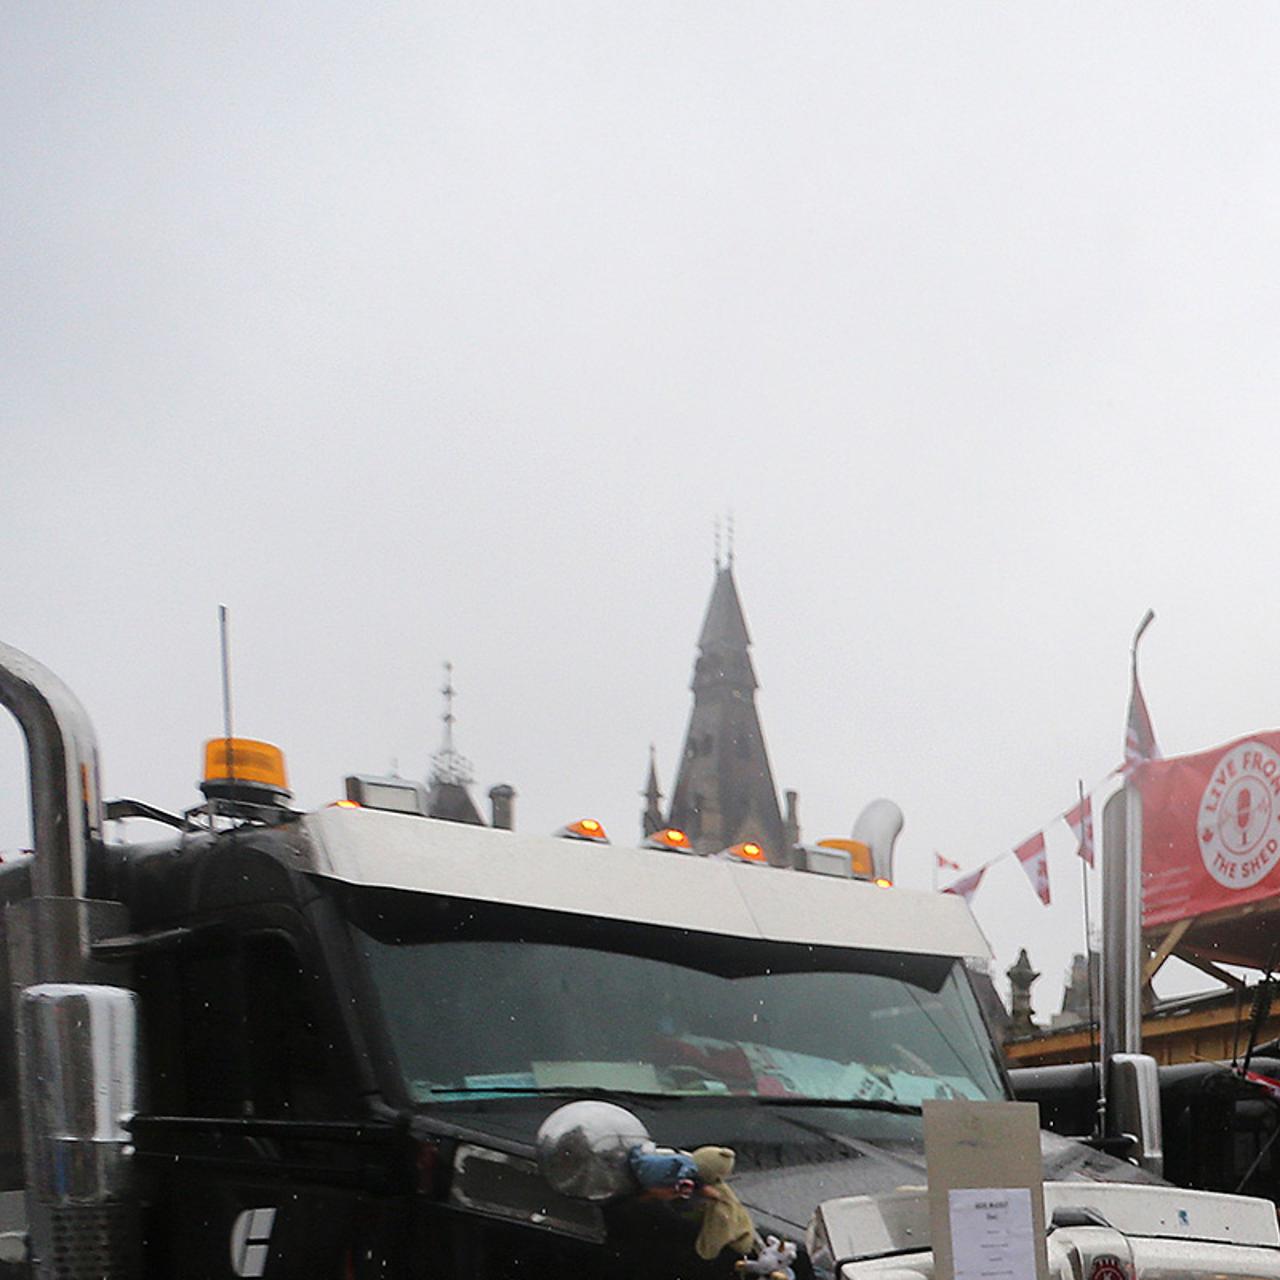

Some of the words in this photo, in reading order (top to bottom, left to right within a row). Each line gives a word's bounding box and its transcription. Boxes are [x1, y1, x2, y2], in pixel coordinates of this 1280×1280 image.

[1206, 760, 1237, 812] LIVE
[1213, 852, 1237, 880] THE
[1241, 839, 1279, 879] SHED
